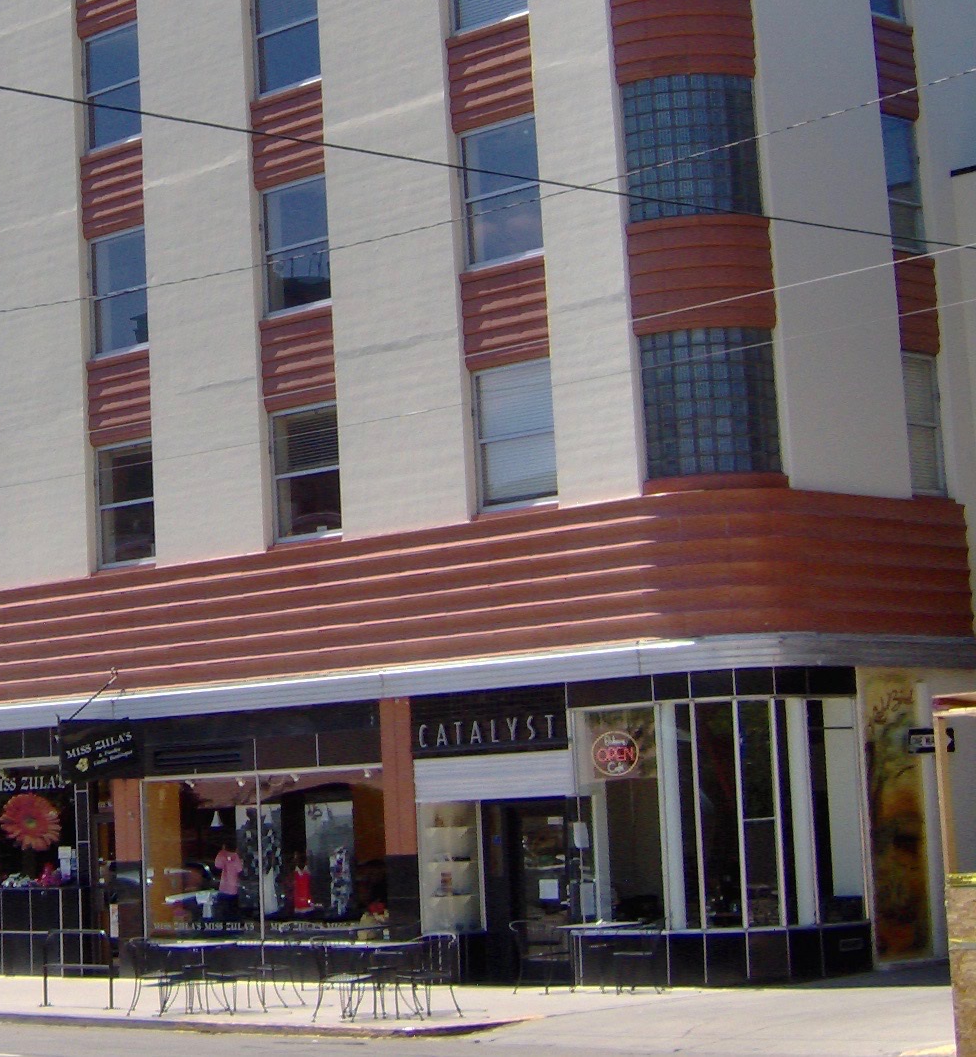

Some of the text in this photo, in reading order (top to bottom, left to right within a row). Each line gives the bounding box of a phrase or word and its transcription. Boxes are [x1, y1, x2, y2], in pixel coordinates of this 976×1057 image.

[418, 714, 555, 748] CATALYST
[65, 731, 133, 759] MISS ZULA'S
[597, 746, 634, 762] OPEN
[204, 922, 223, 931] MISS
[225, 922, 255, 931] ZULA'S
